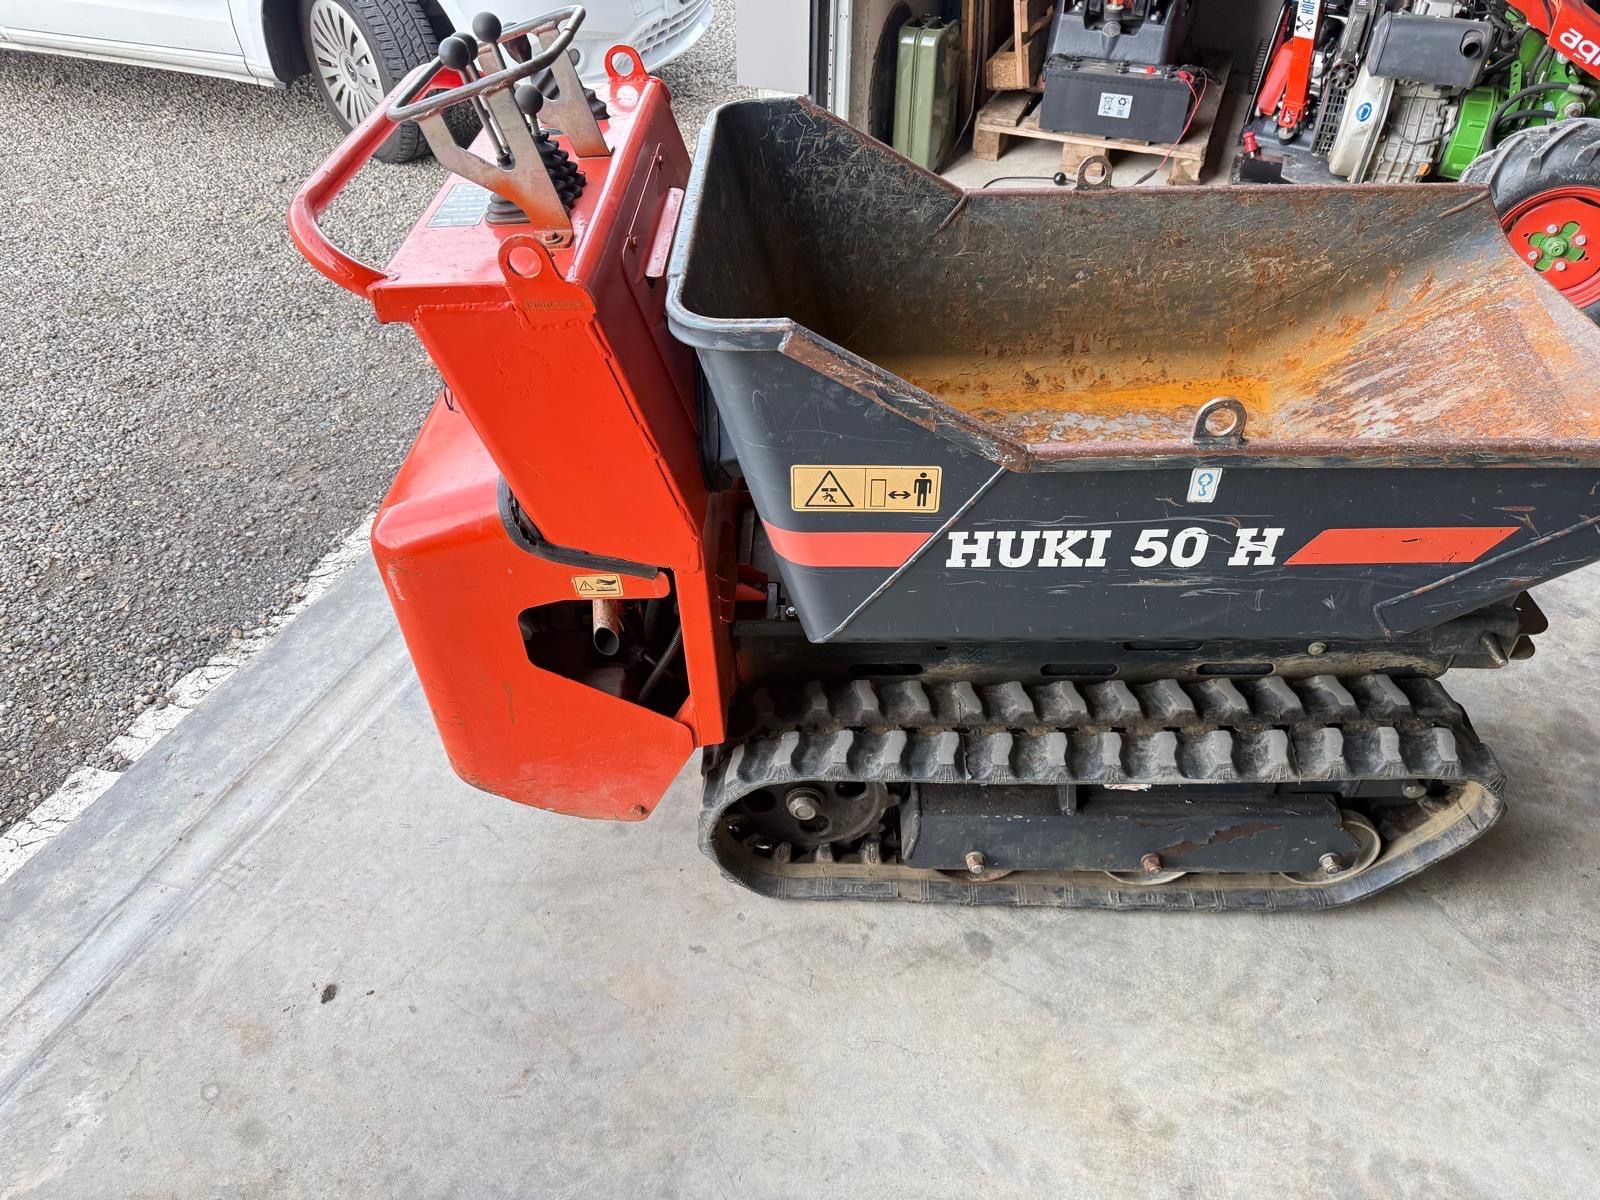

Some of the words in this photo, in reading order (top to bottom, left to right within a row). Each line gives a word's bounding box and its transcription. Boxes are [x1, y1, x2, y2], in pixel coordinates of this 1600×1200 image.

[945, 530, 1112, 568] HUKI
[1130, 527, 1210, 568] 50
[1227, 528, 1285, 566] H
